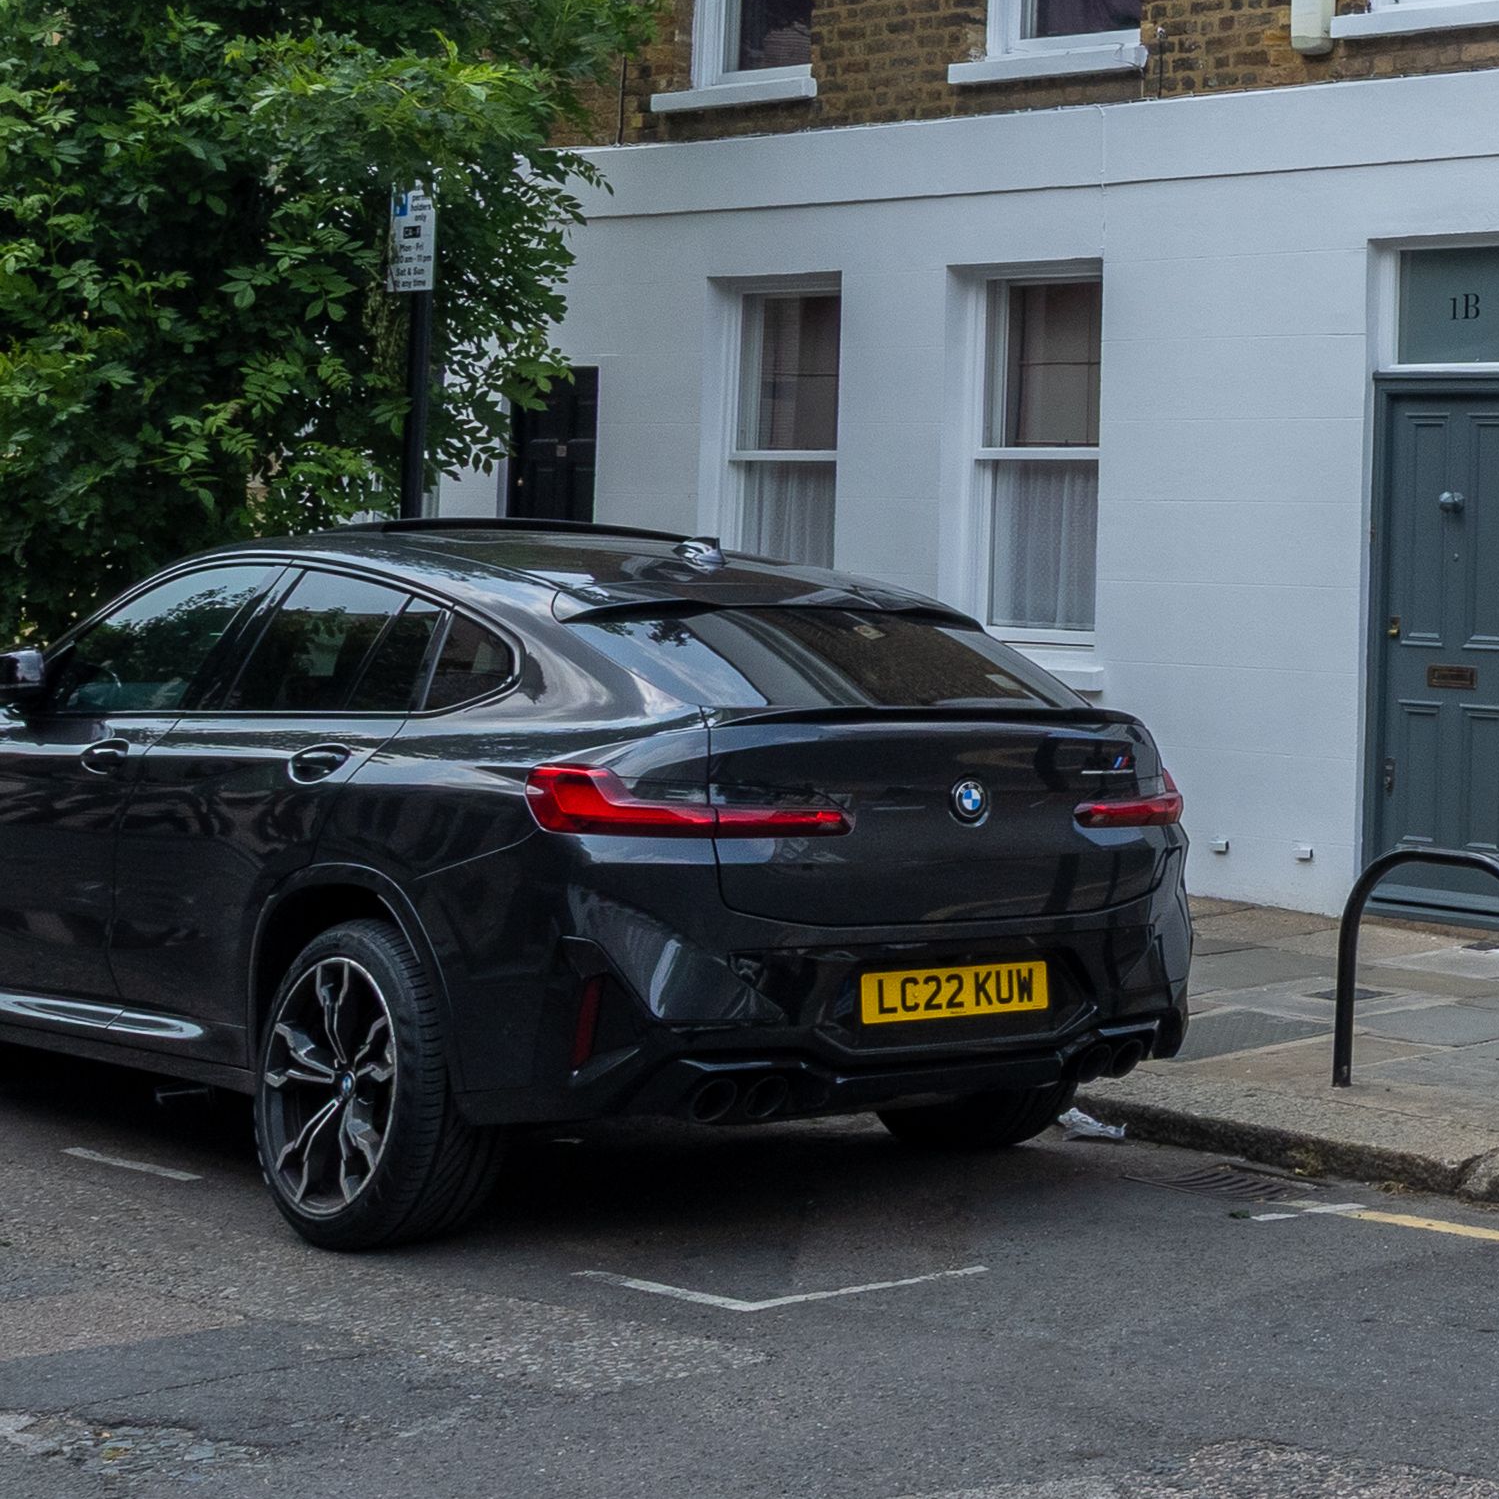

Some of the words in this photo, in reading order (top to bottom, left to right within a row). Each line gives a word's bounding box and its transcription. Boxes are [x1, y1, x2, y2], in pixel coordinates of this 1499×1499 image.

[1449, 293, 1480, 320] 1B
[877, 974, 965, 1015] LC22
[974, 968, 1034, 1006] KUW
